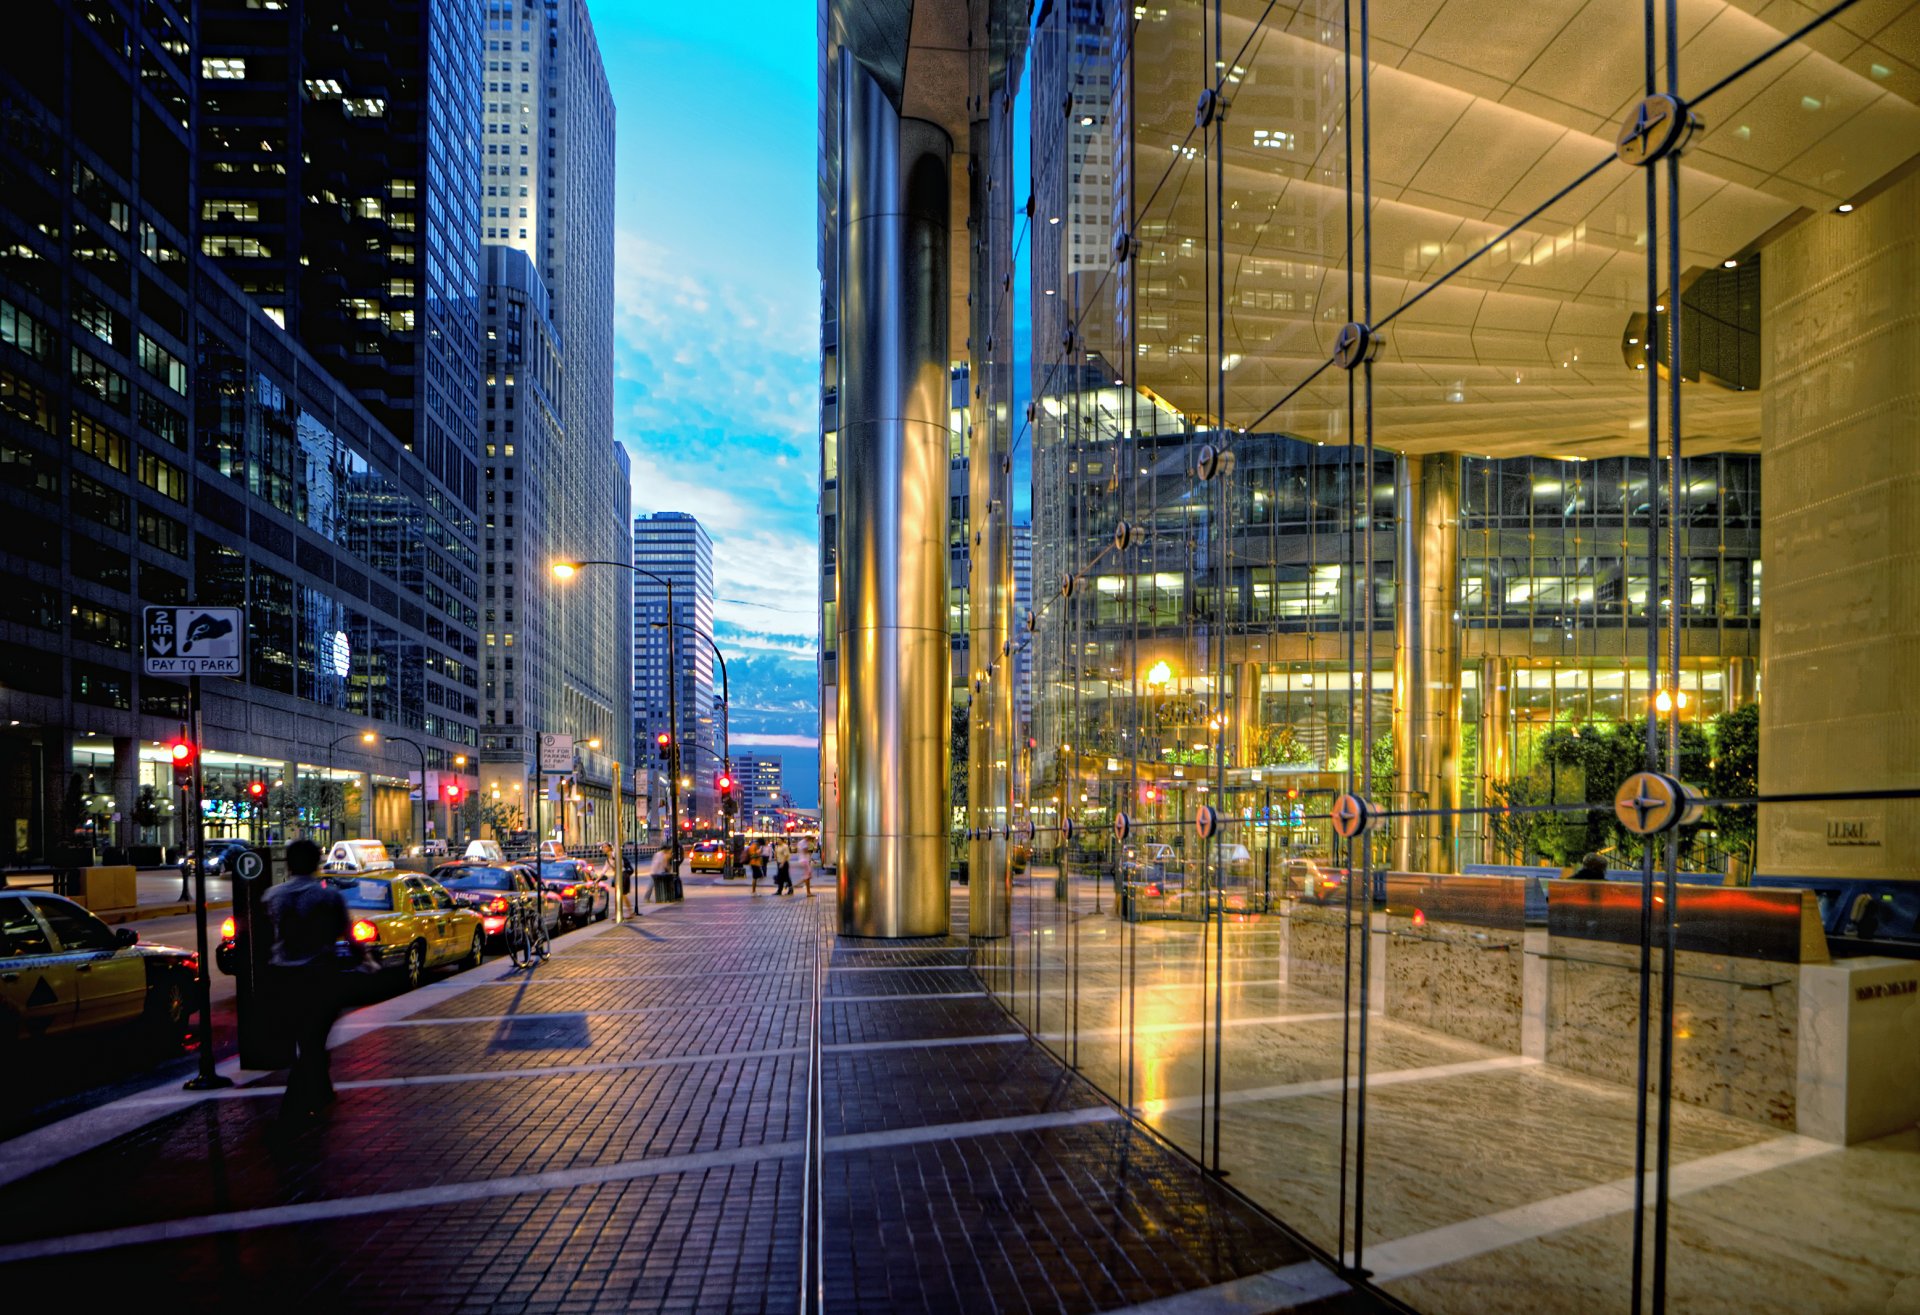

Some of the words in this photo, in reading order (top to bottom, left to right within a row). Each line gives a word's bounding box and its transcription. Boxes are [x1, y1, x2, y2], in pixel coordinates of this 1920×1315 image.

[155, 611, 169, 624] 2
[150, 624, 173, 635] HR
[152, 660, 176, 670] PAY
[181, 660, 196, 671] TO
[201, 660, 234, 670] PARK
[244, 856, 256, 875] P
